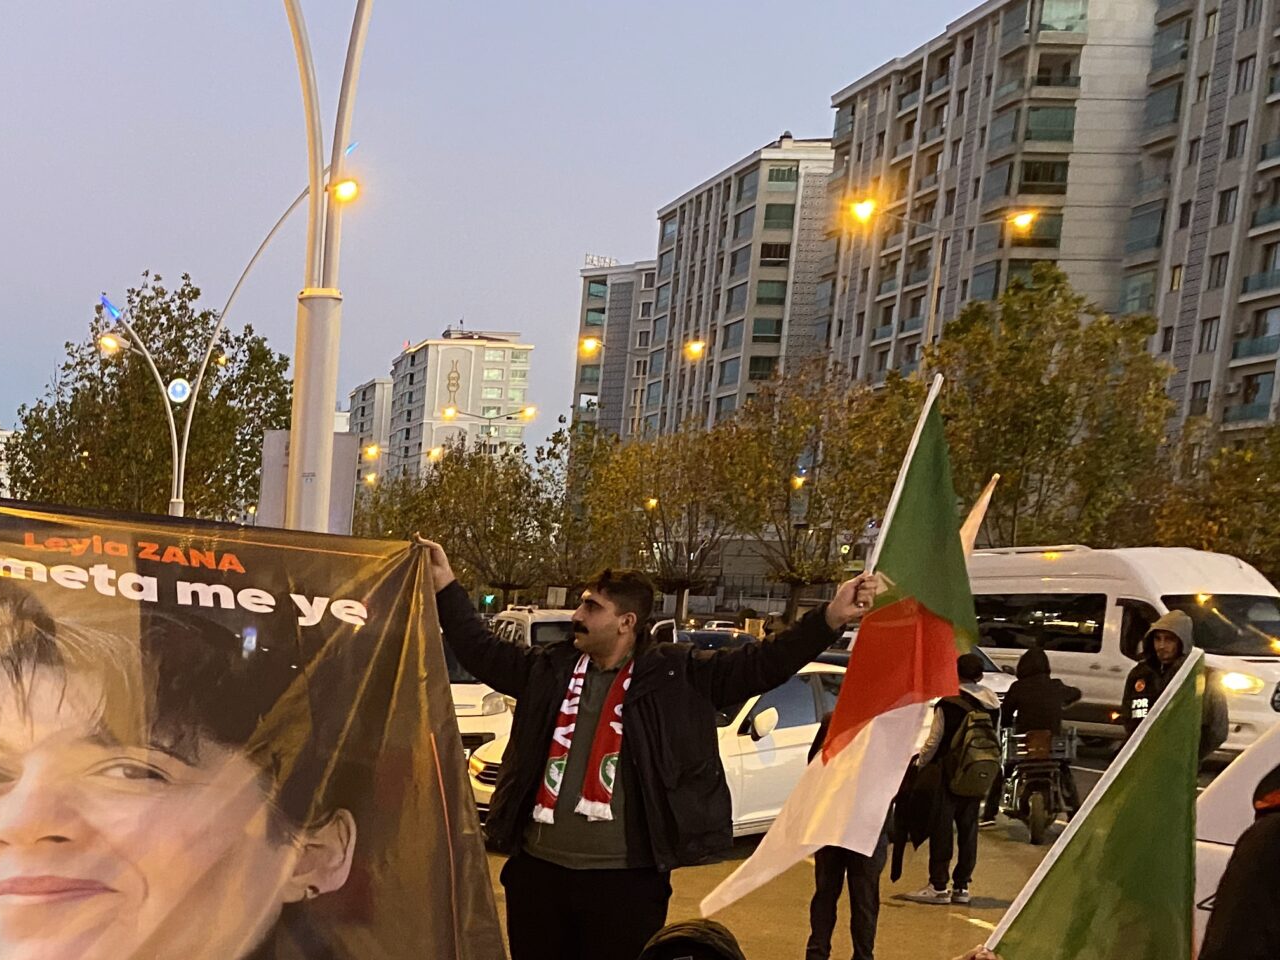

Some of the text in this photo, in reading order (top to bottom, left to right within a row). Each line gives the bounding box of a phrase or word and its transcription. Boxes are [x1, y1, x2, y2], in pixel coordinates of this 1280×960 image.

[24, 532, 246, 574] Leyla ZANA
[176, 580, 276, 613] me
[289, 593, 368, 627] ye
